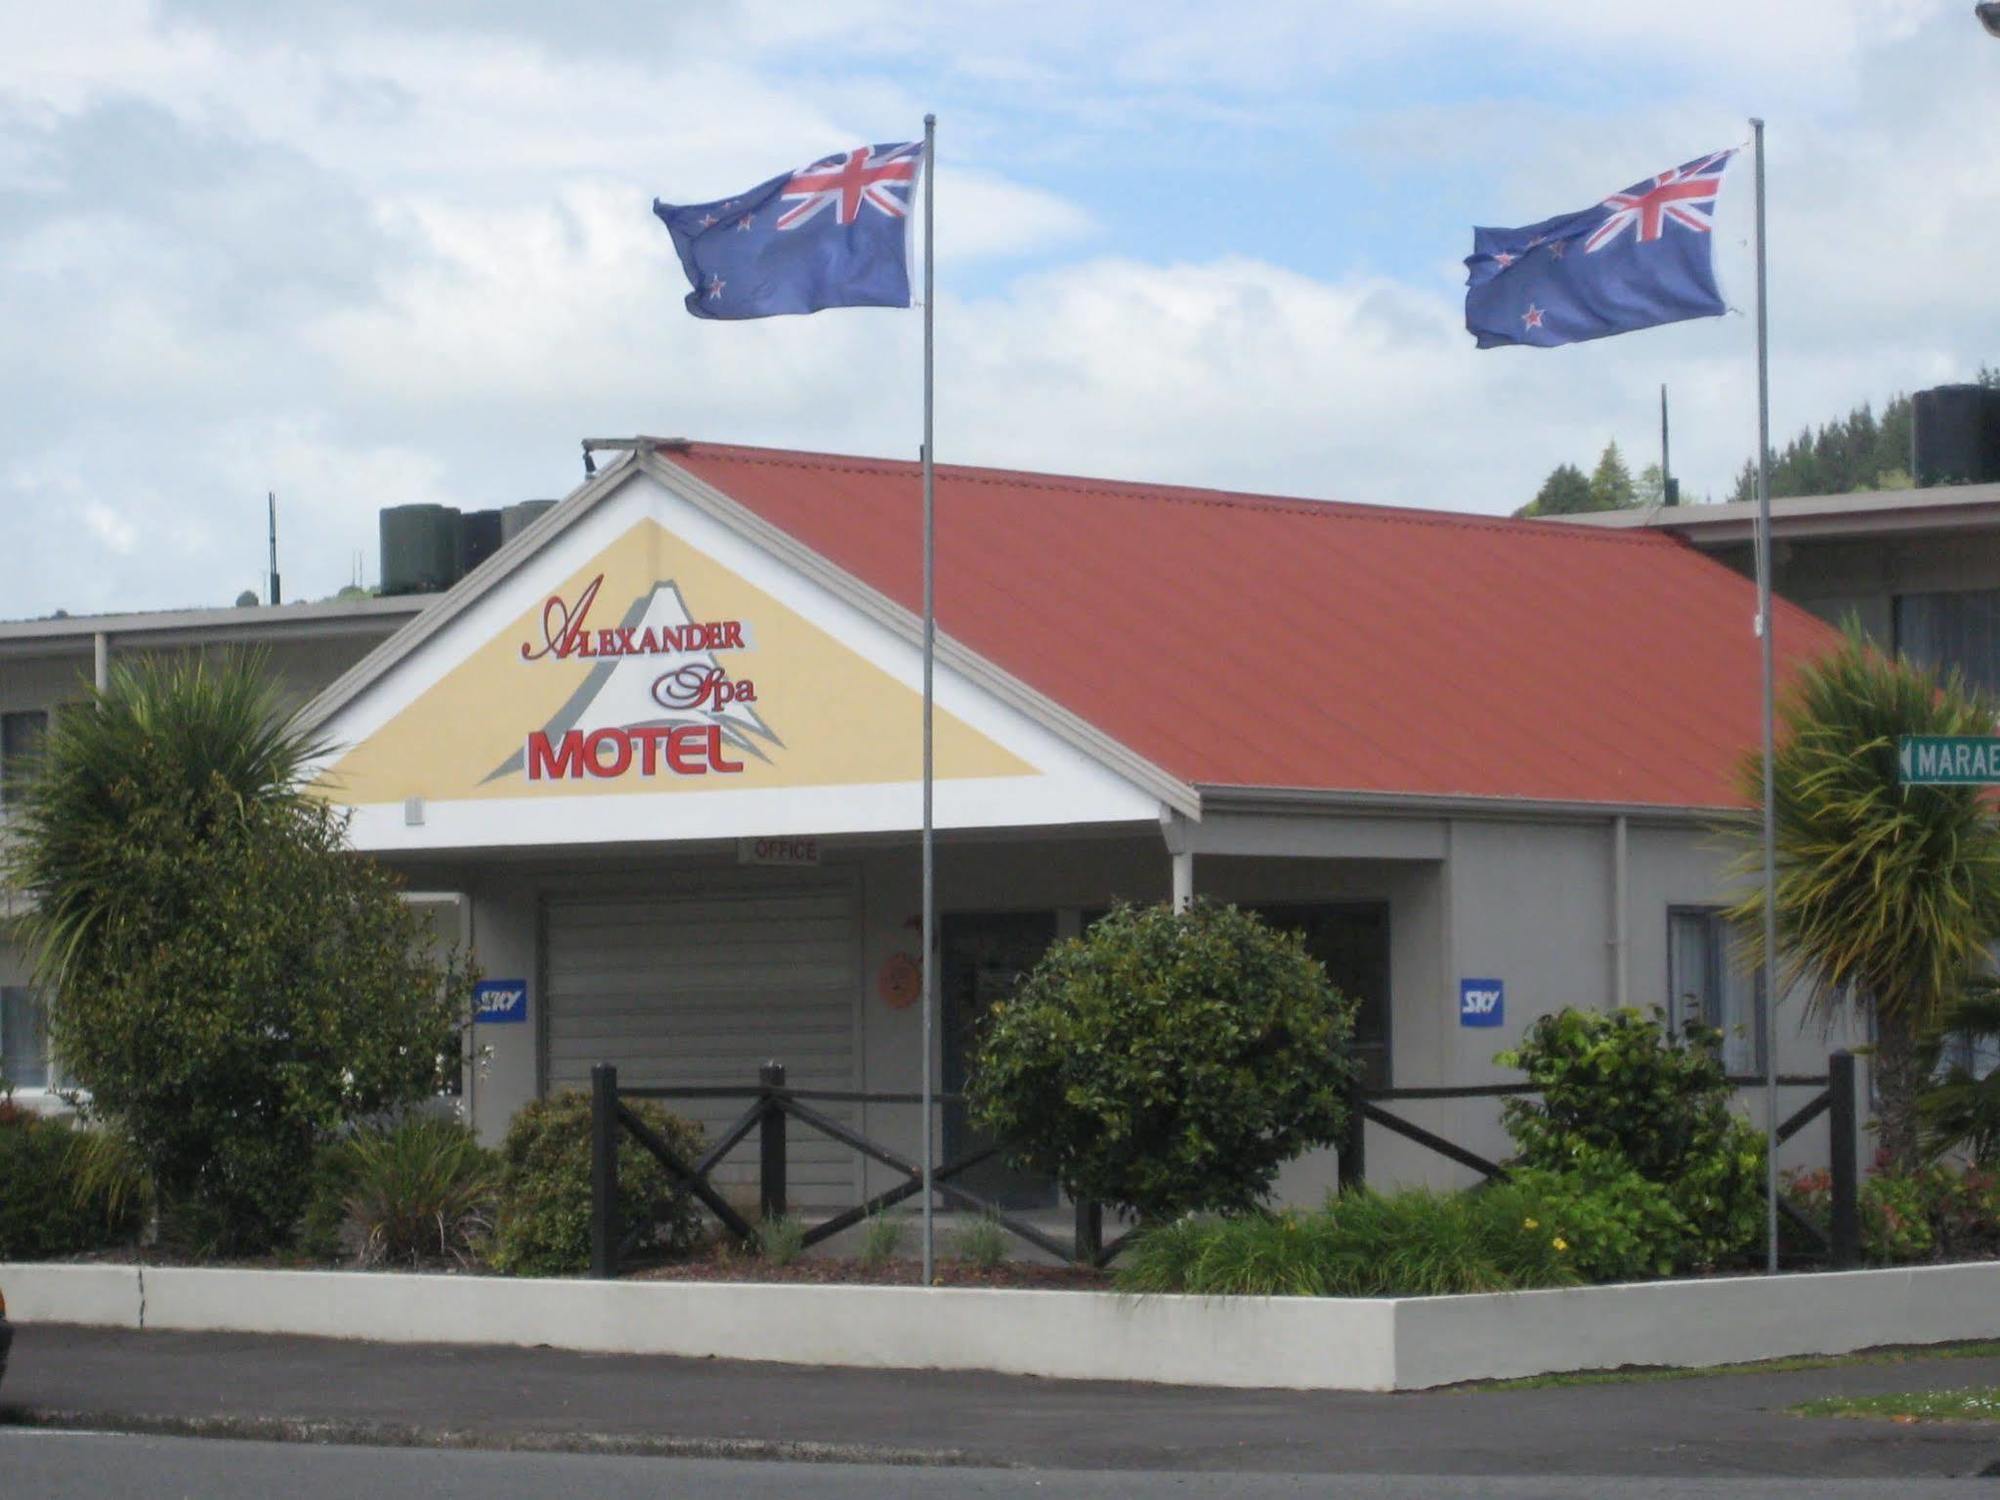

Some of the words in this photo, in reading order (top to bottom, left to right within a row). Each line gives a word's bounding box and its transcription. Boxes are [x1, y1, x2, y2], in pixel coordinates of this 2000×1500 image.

[521, 573, 745, 661] ALEXANDER
[651, 663, 757, 712] Spa
[528, 725, 744, 780] MOTEL
[756, 838, 817, 860] OFFICE
[1462, 991, 1500, 1013] SKY
